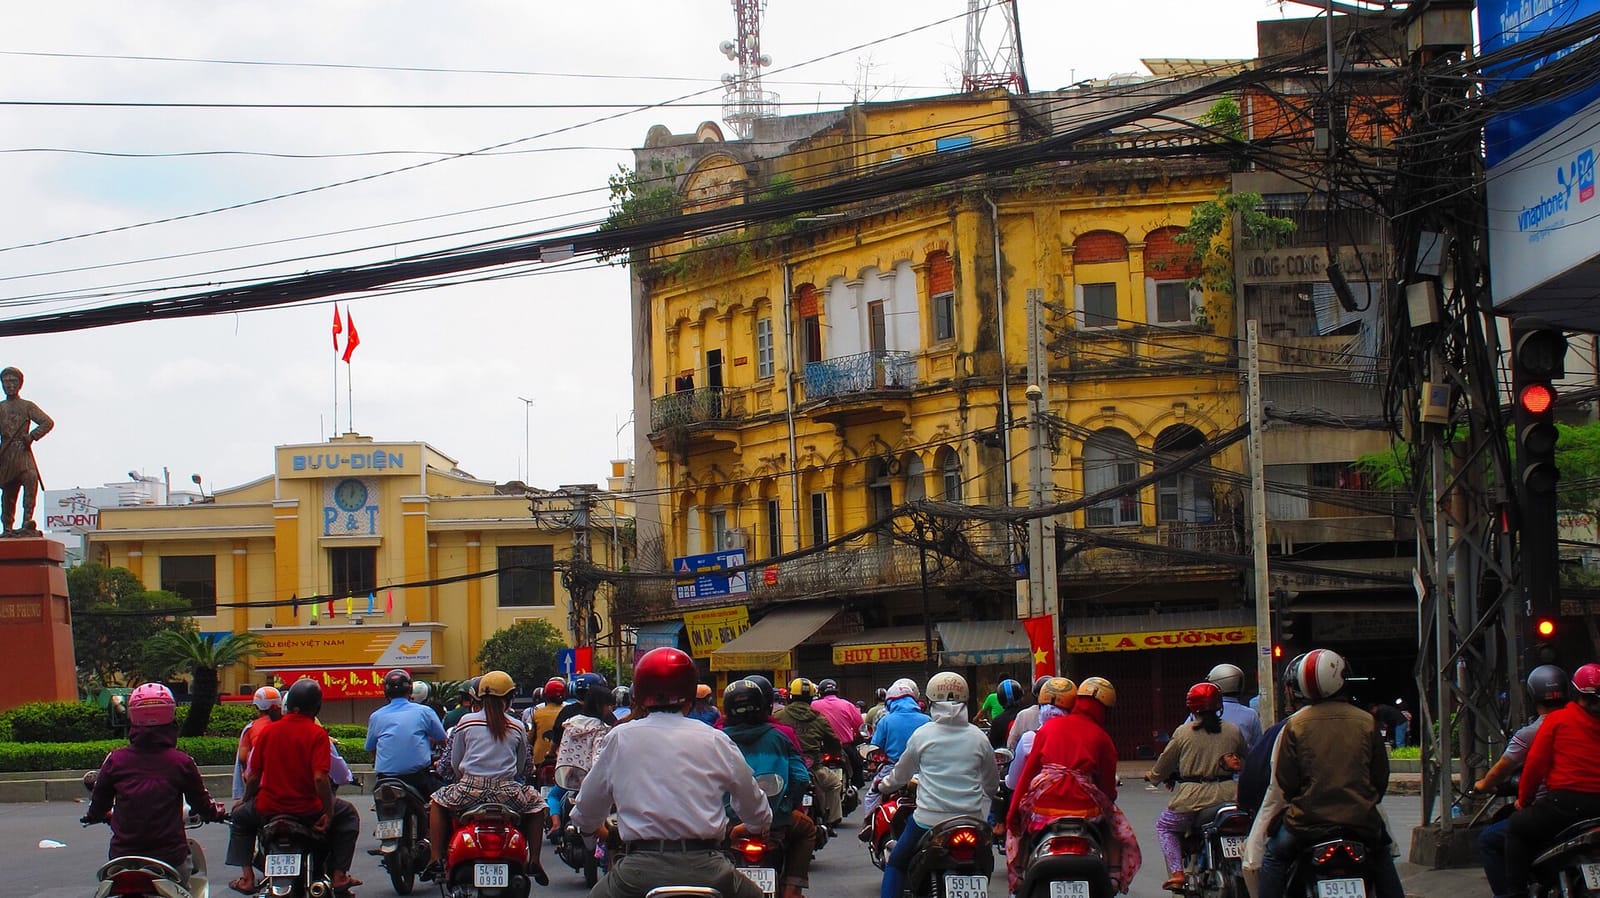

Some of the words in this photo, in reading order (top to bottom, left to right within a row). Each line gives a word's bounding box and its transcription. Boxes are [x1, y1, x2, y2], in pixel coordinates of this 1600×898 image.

[1518, 191, 1563, 232] vinaphone
[324, 506, 338, 536] P
[365, 505, 379, 535] T
[1115, 637, 1137, 648] A
[1143, 630, 1243, 647] CƯỜNG
[844, 648, 873, 663] HUY
[878, 643, 921, 660] HÙNG
[479, 875, 503, 886] 0930
[952, 878, 981, 890] 59-L1
[1325, 880, 1358, 895] 59-L1
